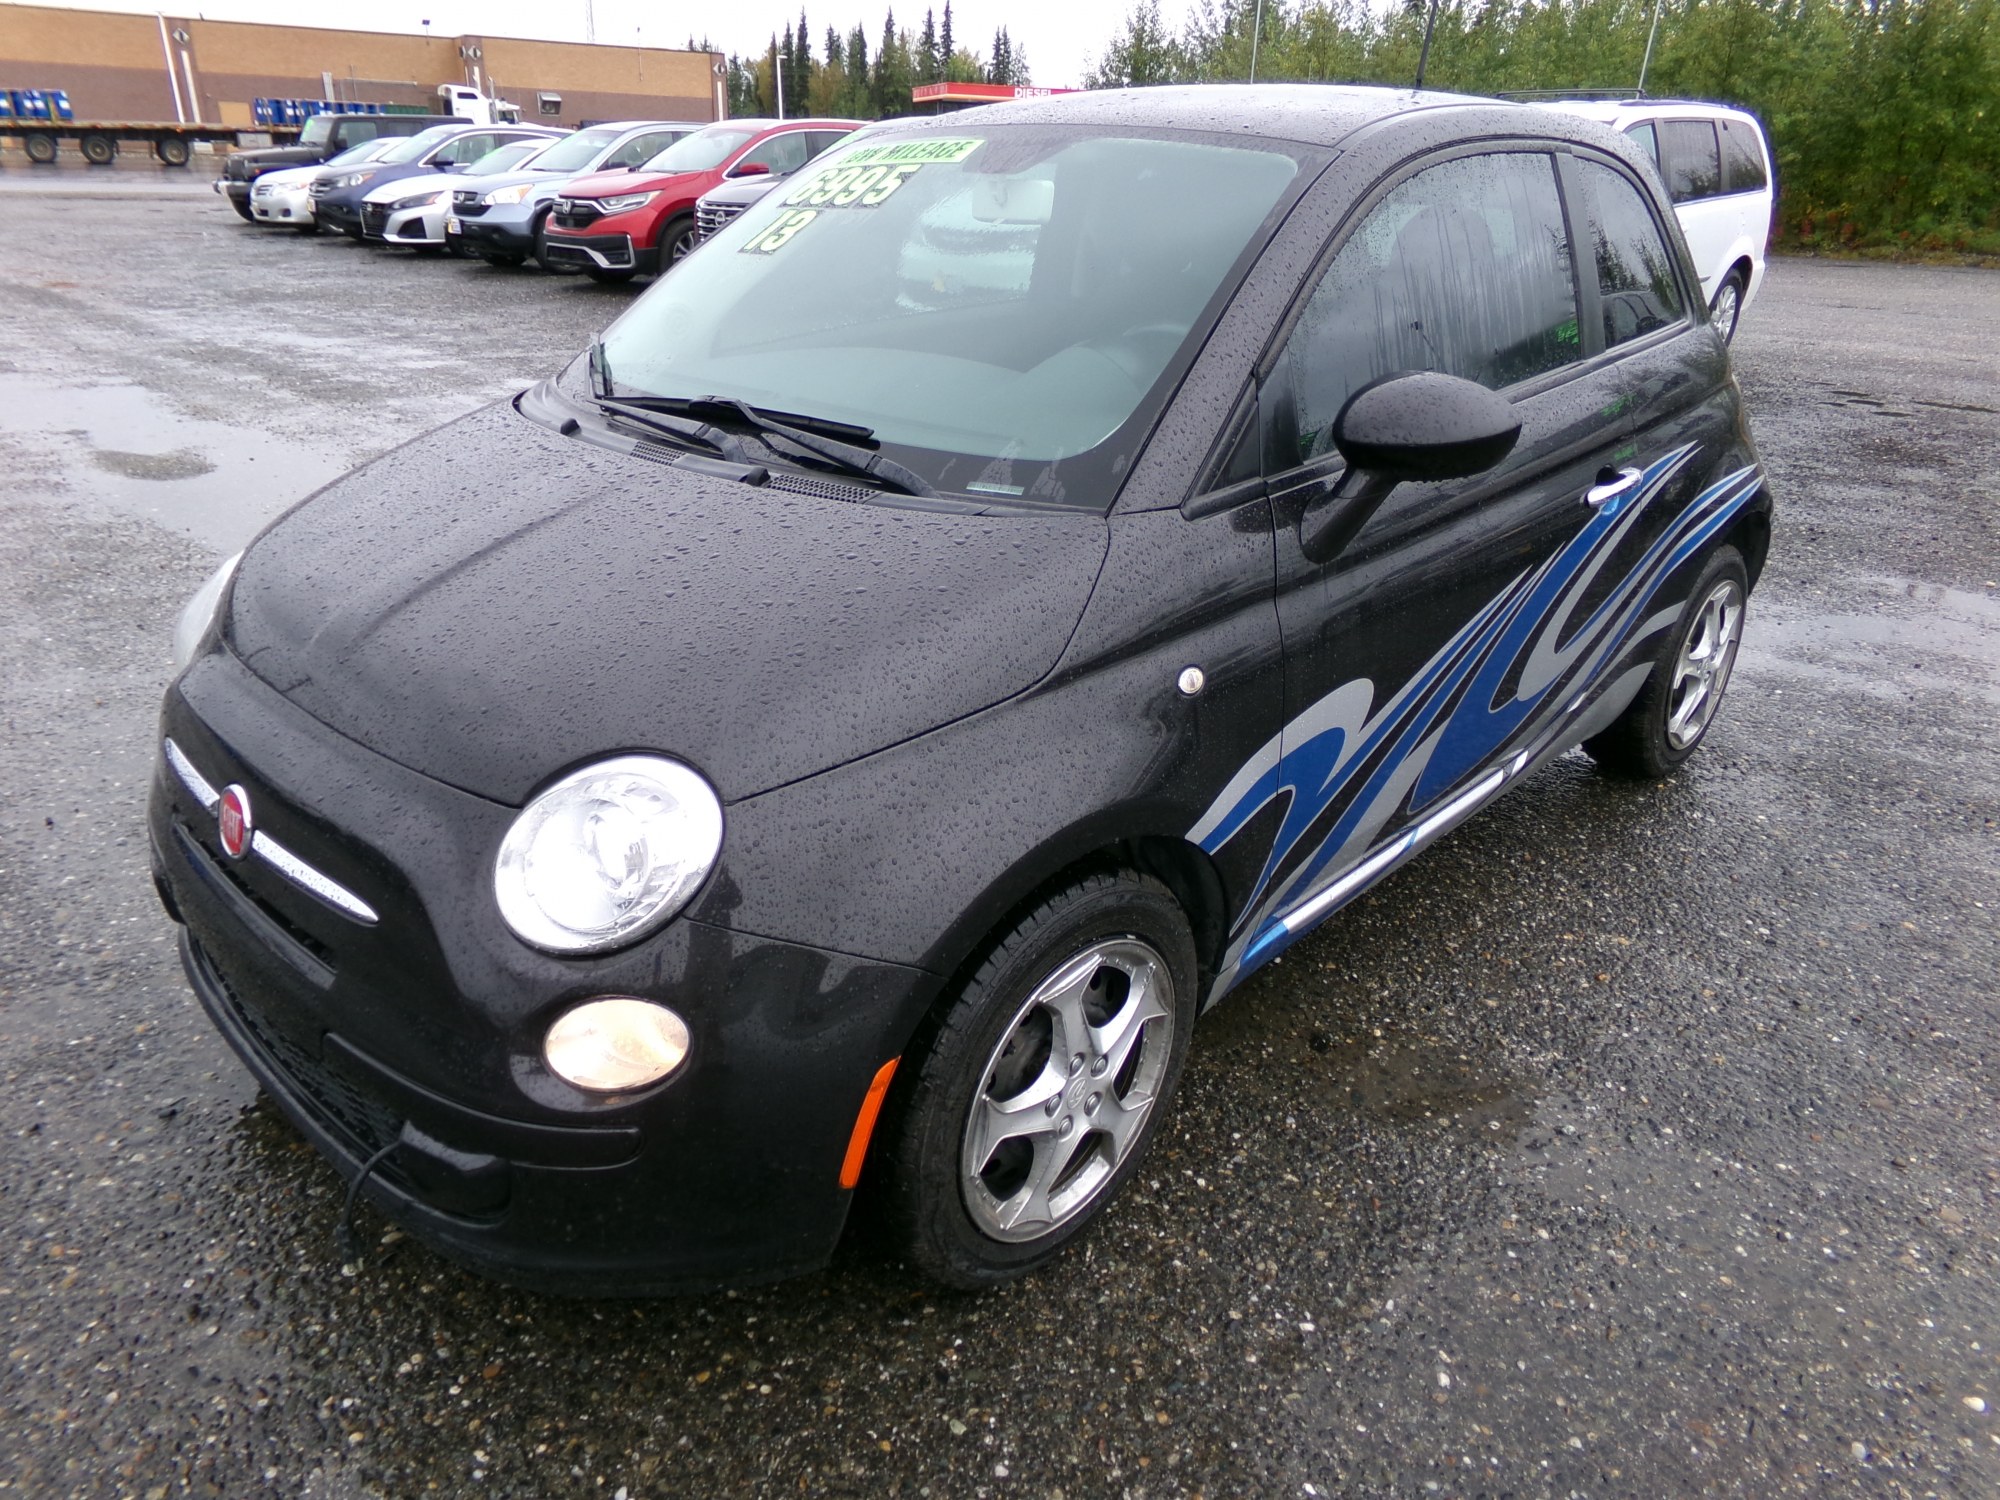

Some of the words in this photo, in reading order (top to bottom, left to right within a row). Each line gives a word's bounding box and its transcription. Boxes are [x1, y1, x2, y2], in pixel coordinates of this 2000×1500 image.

[877, 141, 975, 160] MILEAGE
[785, 163, 923, 206] 6995
[743, 209, 818, 252] 13
